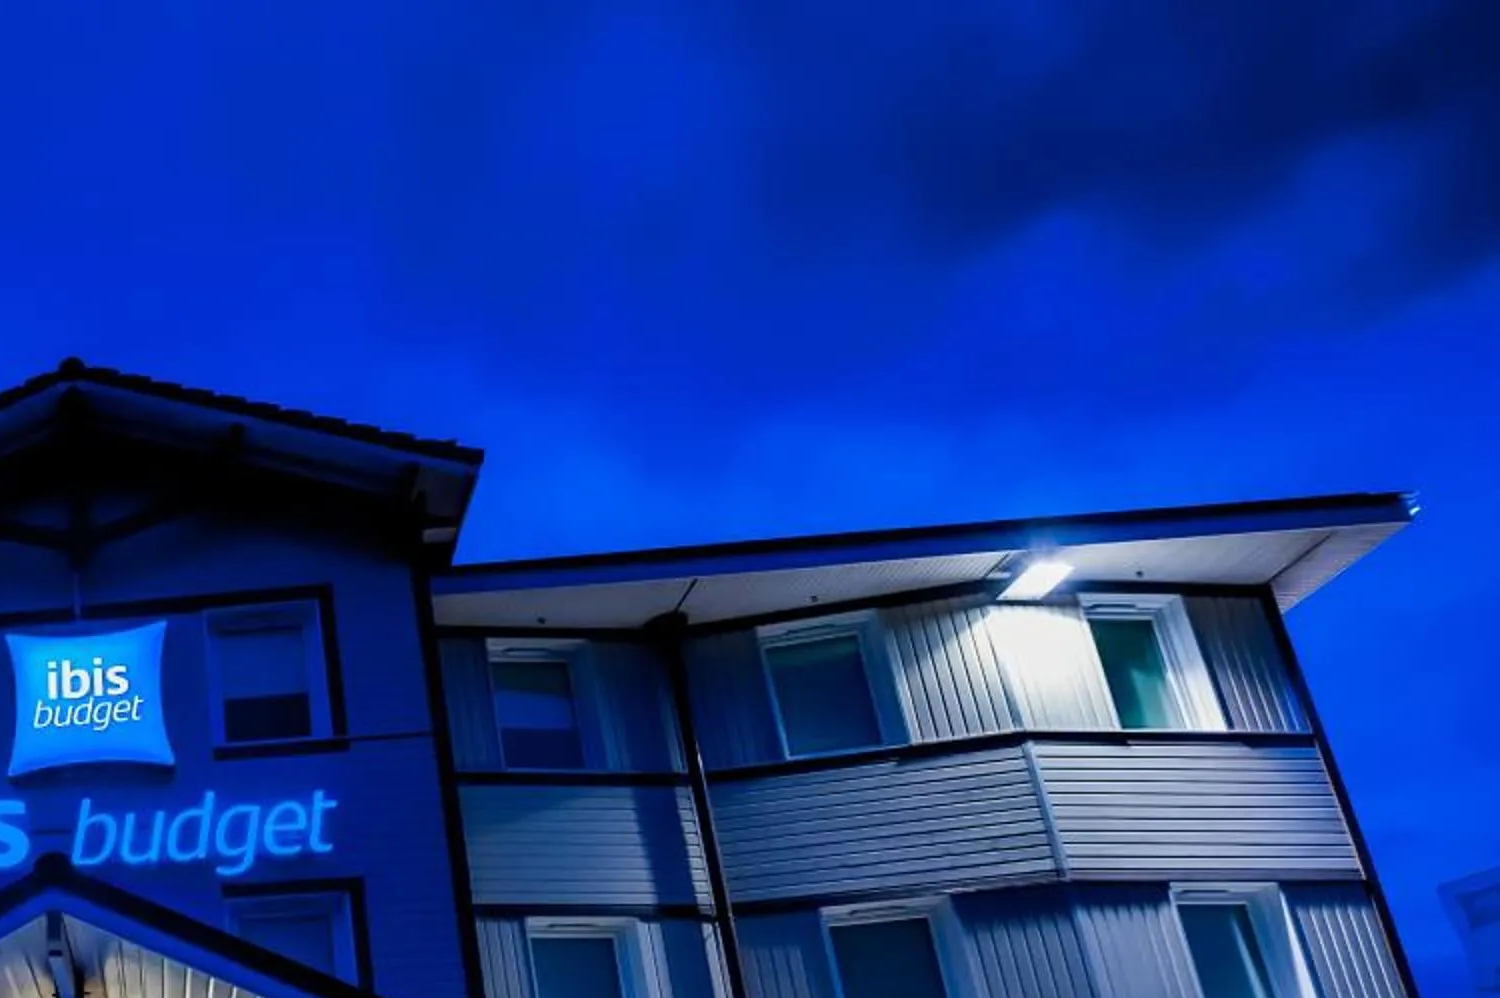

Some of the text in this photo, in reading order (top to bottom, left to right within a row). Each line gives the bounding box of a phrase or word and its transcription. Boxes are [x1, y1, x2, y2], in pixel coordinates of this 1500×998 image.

[47, 657, 129, 700] ibis
[33, 694, 143, 731] budget
[72, 790, 337, 876] budget
